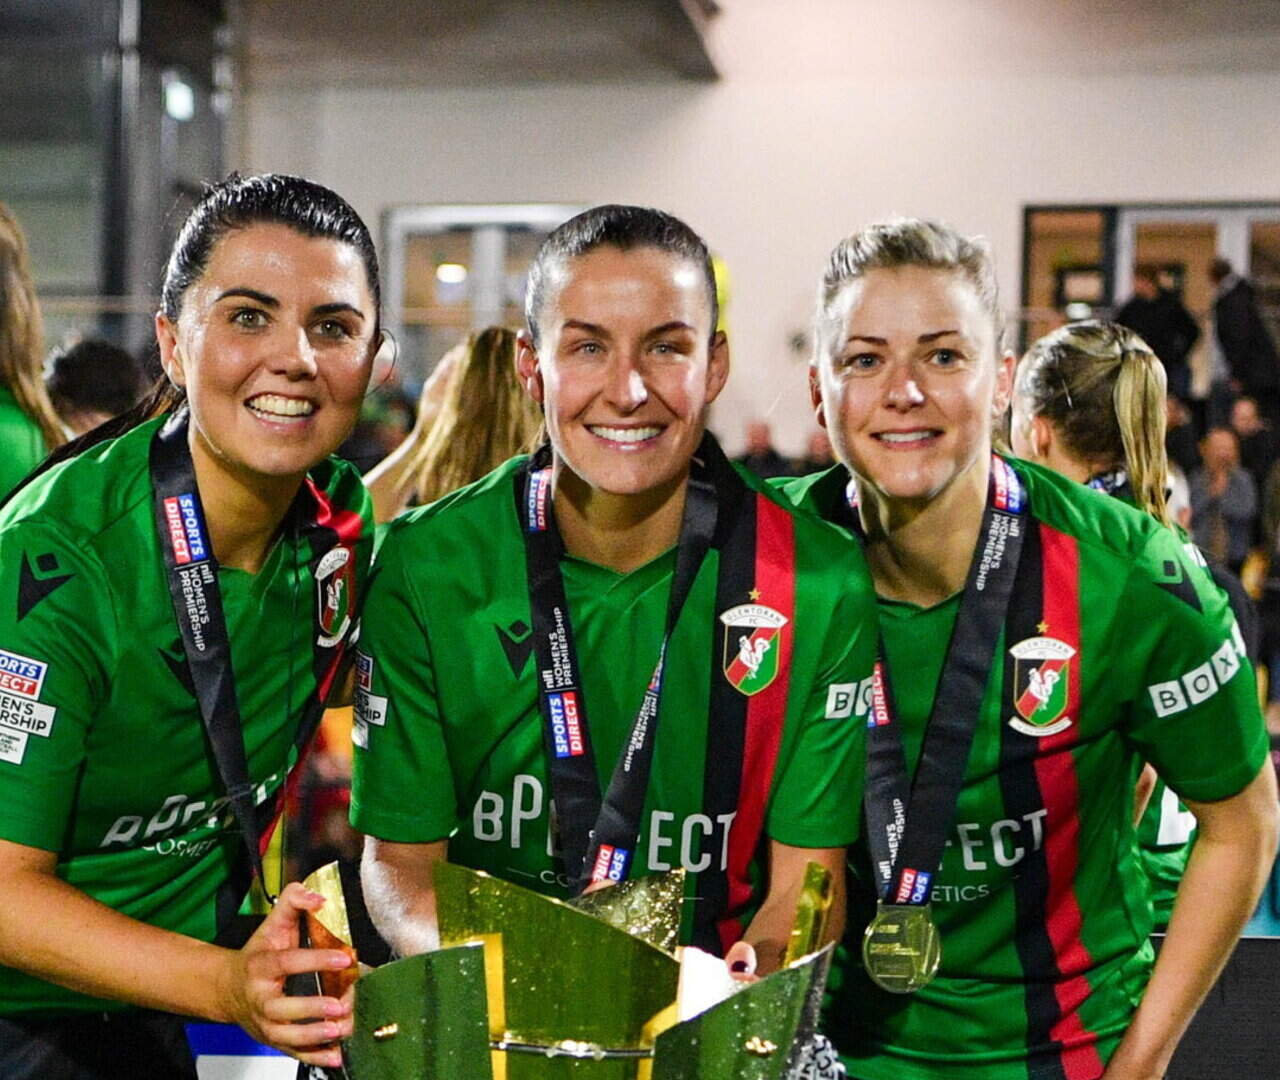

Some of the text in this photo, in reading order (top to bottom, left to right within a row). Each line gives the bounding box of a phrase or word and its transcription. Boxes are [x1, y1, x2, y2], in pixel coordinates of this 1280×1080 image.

[166, 503, 189, 560] DIRECT
[180, 498, 204, 557] SPORTS
[976, 513, 1001, 591] PREMIERSHIP
[190, 566, 210, 626] WOMEN'S
[200, 564, 215, 584] nifl
[179, 570, 206, 652] PREMIERSHIP
[548, 632, 563, 688] WOMEN'S
[554, 606, 572, 686] PREMIERSHIP
[549, 698, 569, 754] SPORTS
[564, 697, 583, 753] DIRECT
[473, 774, 737, 873] BPECT
[608, 850, 626, 882] SPO
[911, 873, 929, 903] SPO
